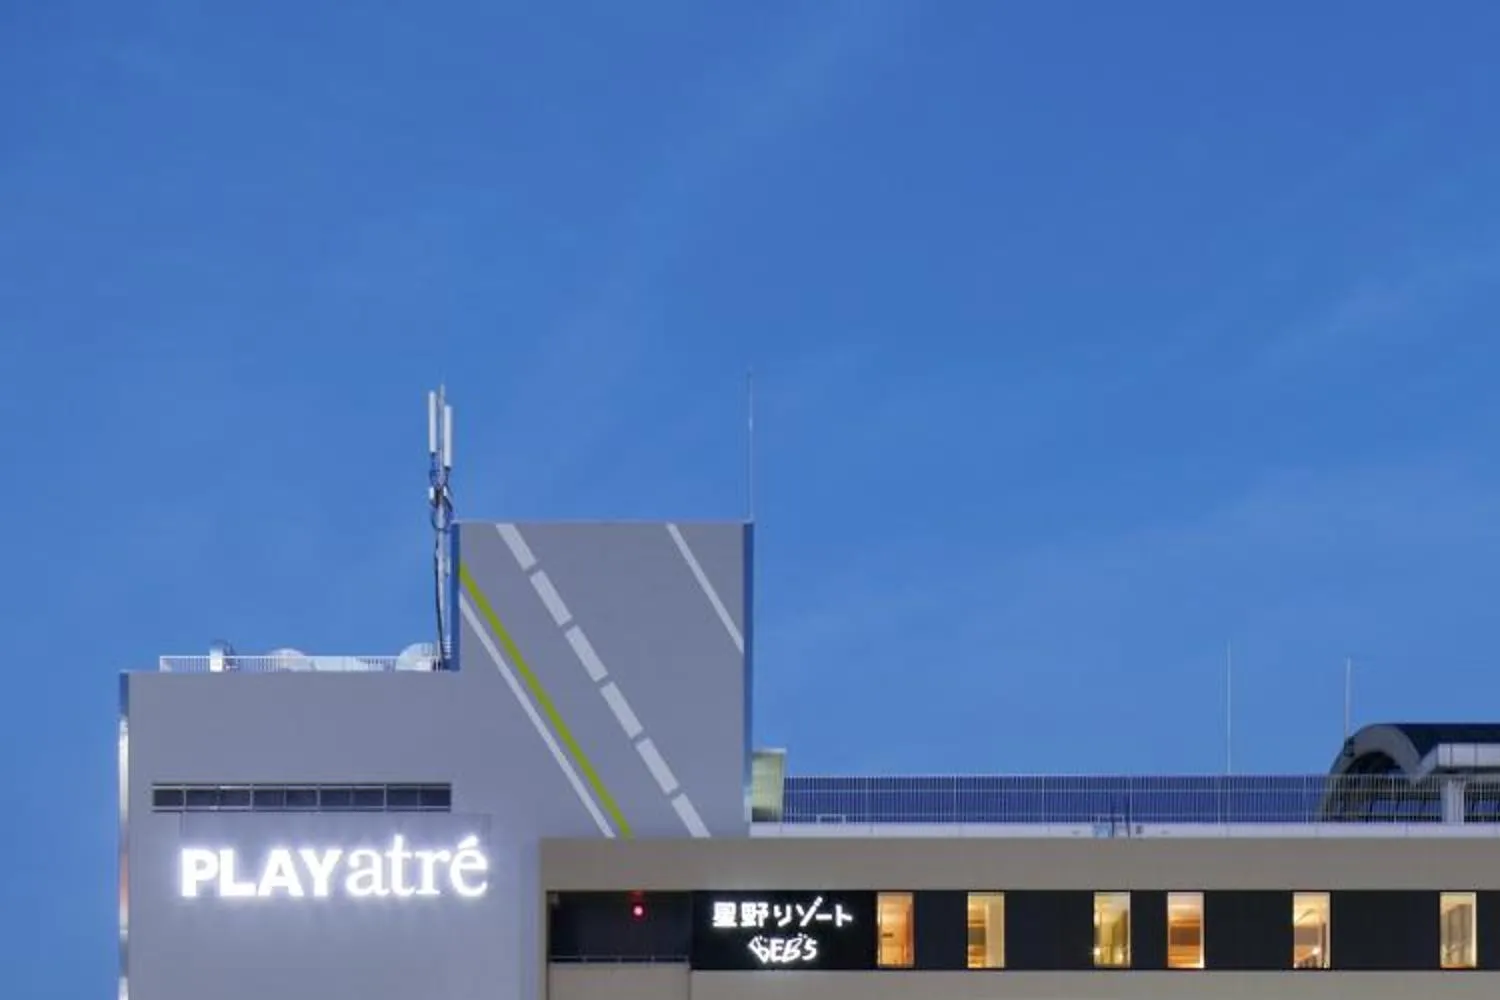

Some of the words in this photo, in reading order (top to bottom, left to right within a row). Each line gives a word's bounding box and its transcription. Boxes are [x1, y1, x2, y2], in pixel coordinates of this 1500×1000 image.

[180, 833, 490, 897] PLAYatré
[712, 896, 853, 928] 星野リゾート
[748, 932, 818, 964] BEB5
